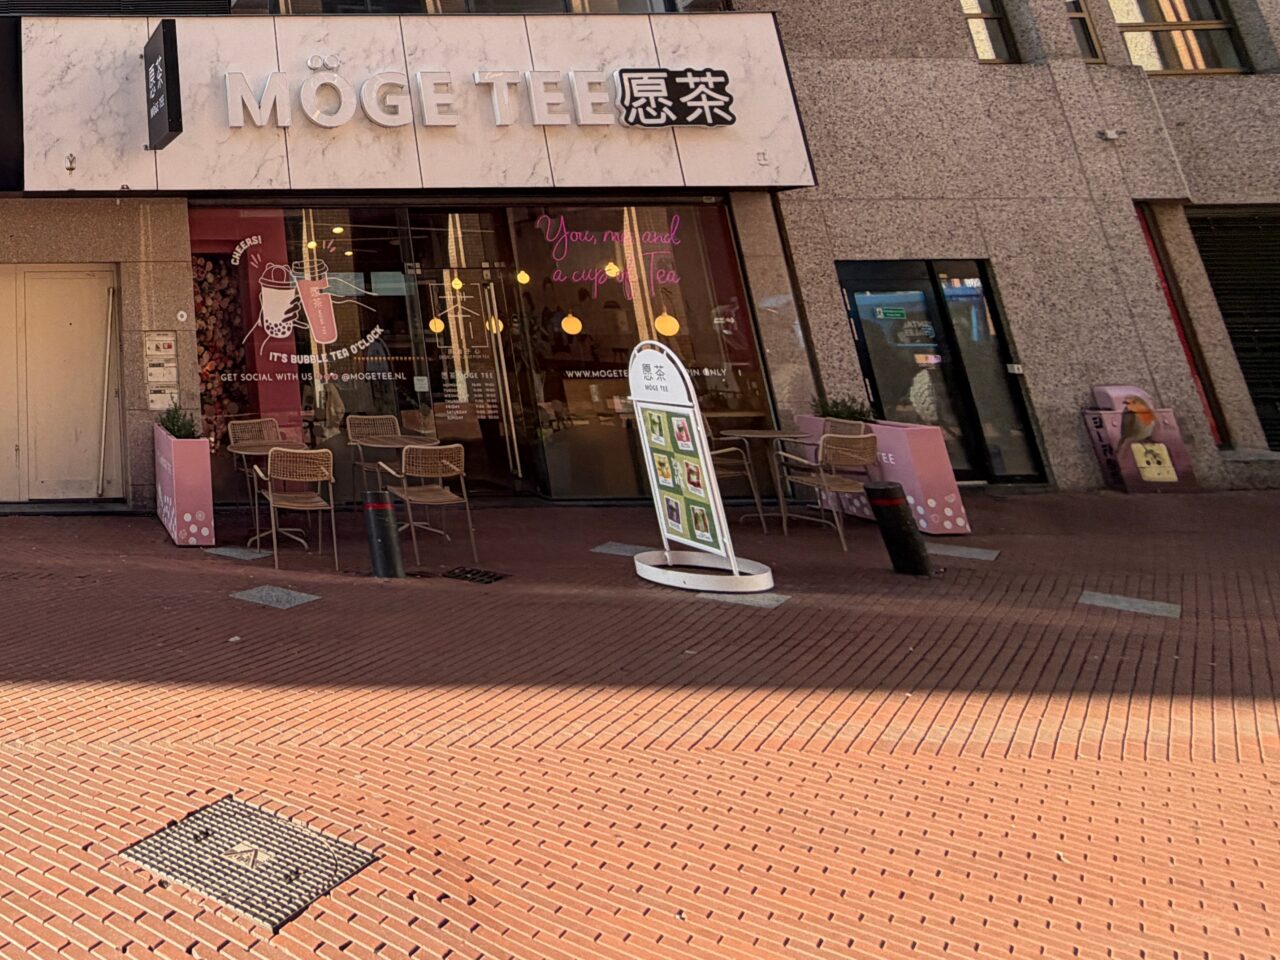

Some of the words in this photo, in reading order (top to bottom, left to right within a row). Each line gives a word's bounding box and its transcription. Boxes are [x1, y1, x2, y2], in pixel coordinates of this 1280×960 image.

[225, 55, 459, 127] MÖGE
[473, 71, 617, 127] TEE
[231, 235, 262, 265] CHEERS!
[535, 214, 597, 261] You,
[641, 214, 681, 245] and
[552, 269, 567, 282] a
[572, 268, 607, 299] cup
[642, 250, 680, 298] Tea
[269, 352, 288, 363] IT'S
[290, 353, 328, 364] BUBBLE
[329, 348, 349, 360] TEA
[350, 324, 385, 354] O'CLOCK
[220, 373, 237, 381] GET
[240, 372, 273, 381] SOCIAL
[276, 372, 298, 381] WITH
[301, 372, 313, 381] US
[341, 371, 407, 382] @MOGETEE.NL
[565, 369, 629, 378] WWW.MOGETE
[702, 368, 727, 376] ONLY
